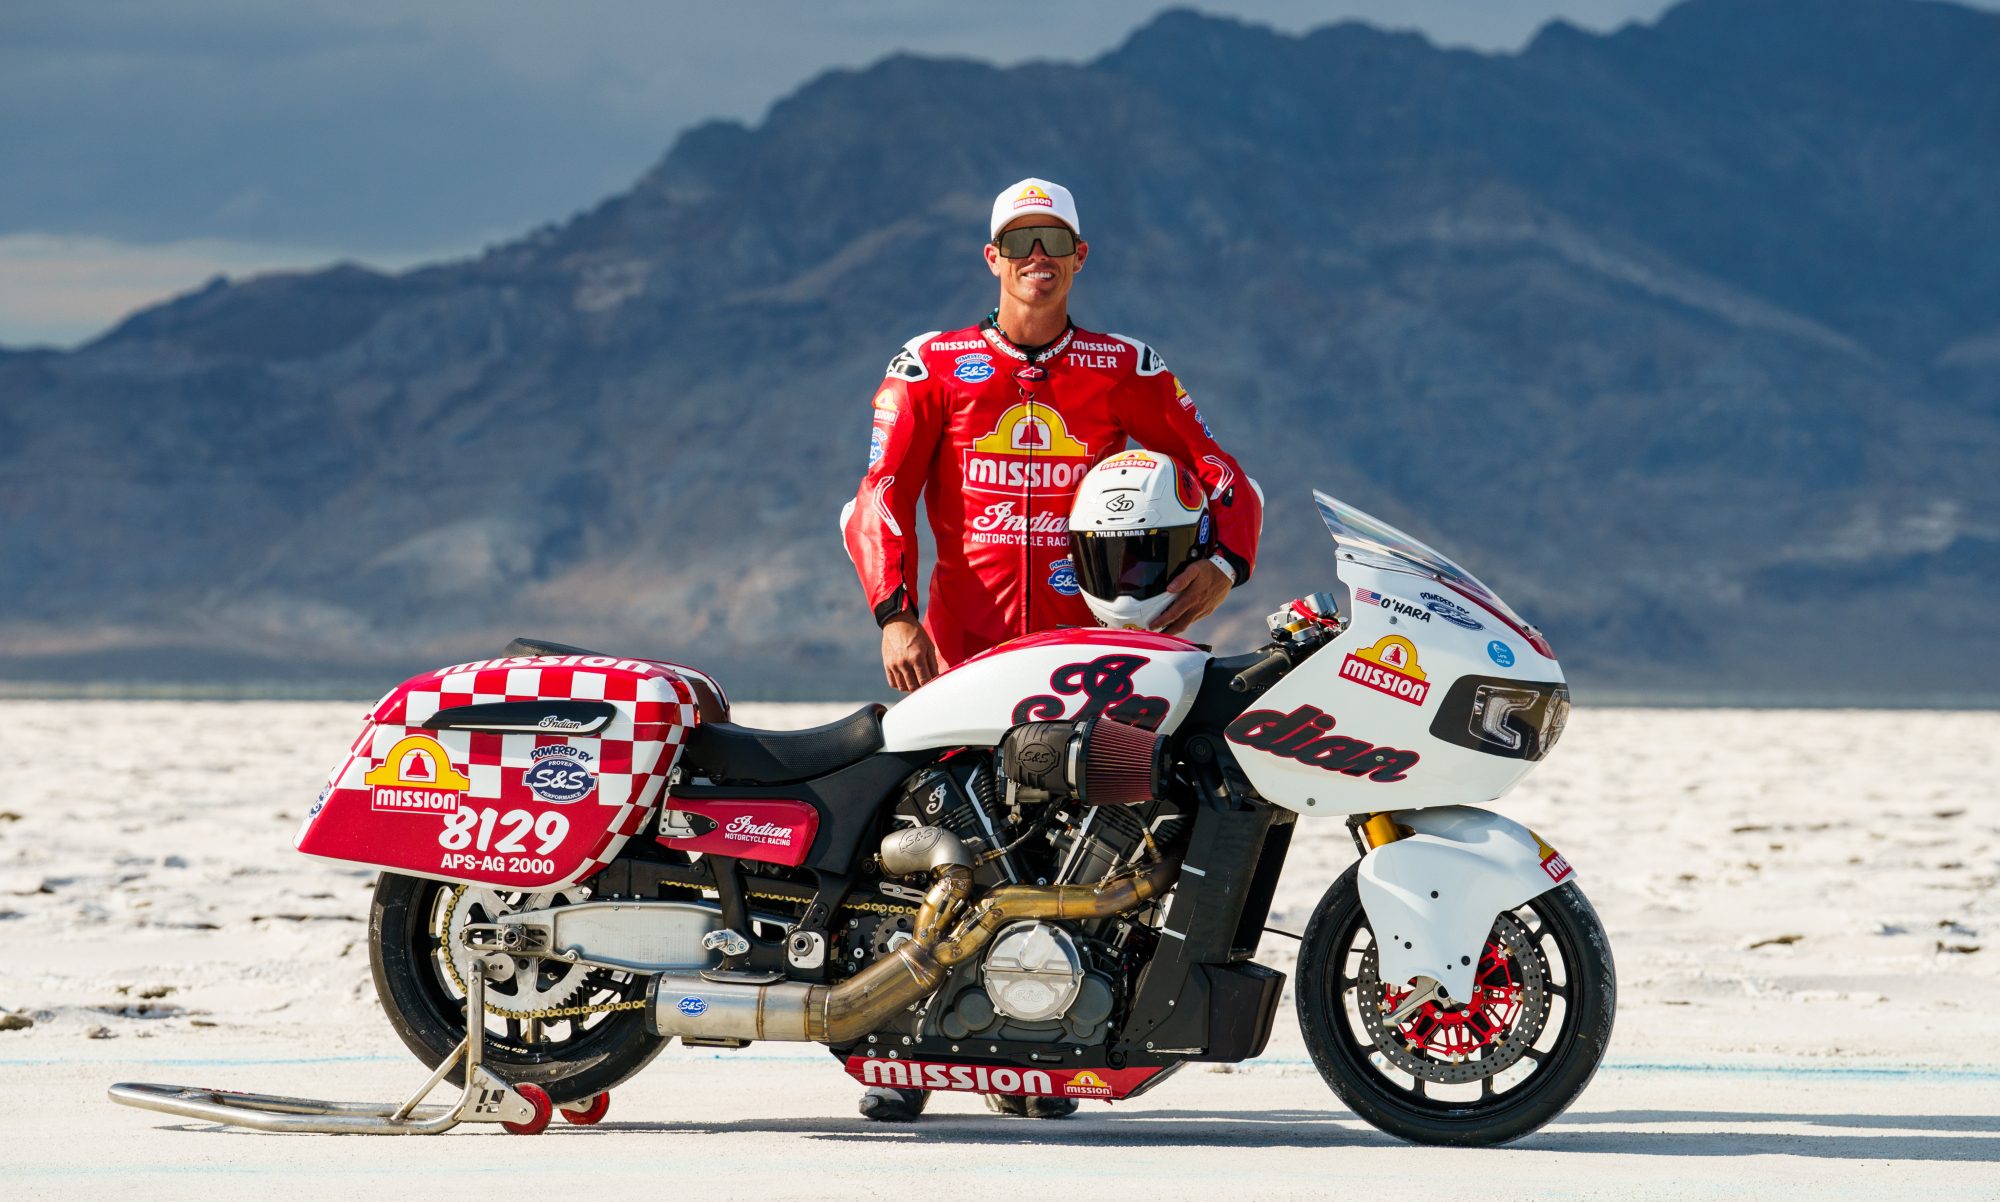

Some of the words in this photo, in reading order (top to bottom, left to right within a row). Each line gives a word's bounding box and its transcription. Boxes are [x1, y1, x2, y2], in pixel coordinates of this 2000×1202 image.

[1068, 353, 1118, 369] TYLER
[960, 365, 989, 378] S&S
[1095, 530, 1116, 538] TYLER
[1117, 529, 1146, 537] O'HARA
[1380, 598, 1431, 622] O'HARA
[538, 715, 582, 730] Indian
[1223, 703, 1420, 783] dian
[530, 745, 578, 761] POWERED
[578, 750, 594, 763] BY
[1022, 751, 1051, 763] S&S
[532, 768, 587, 790] S&S
[540, 789, 582, 801] PERFORMANCE
[438, 805, 570, 856] 8129
[725, 815, 793, 839] Indian
[724, 832, 767, 844] MOTORCYCLE
[767, 837, 792, 847] RACING
[440, 853, 505, 872] APS-AG
[508, 857, 555, 875] 2000
[680, 1001, 703, 1011] S&S
